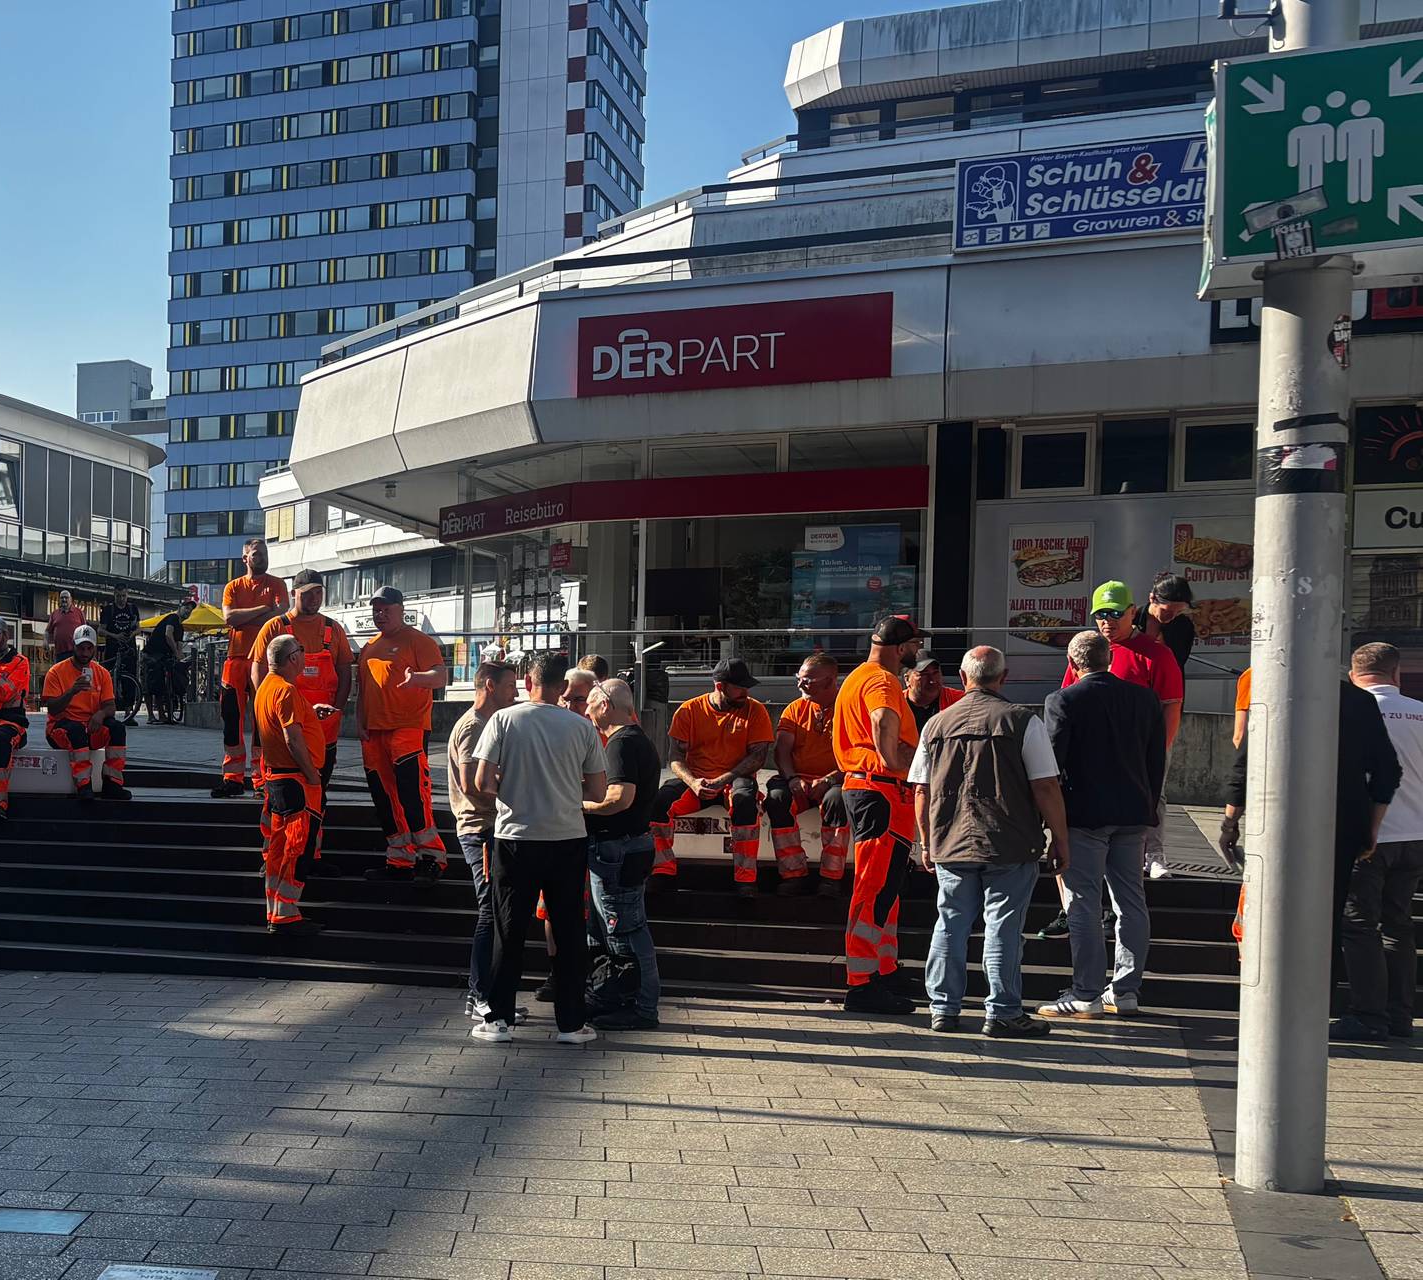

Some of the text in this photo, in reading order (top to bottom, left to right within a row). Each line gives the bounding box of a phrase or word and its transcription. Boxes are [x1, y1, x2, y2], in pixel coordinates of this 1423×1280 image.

[1026, 158, 1122, 188] Schuh
[1073, 214, 1160, 233] Gravuren
[505, 501, 564, 525] Reisebüro
[1035, 538, 1065, 550] TASCHE
[1009, 598, 1036, 611] ALAFEL
[1038, 598, 1064, 611] TELLER
